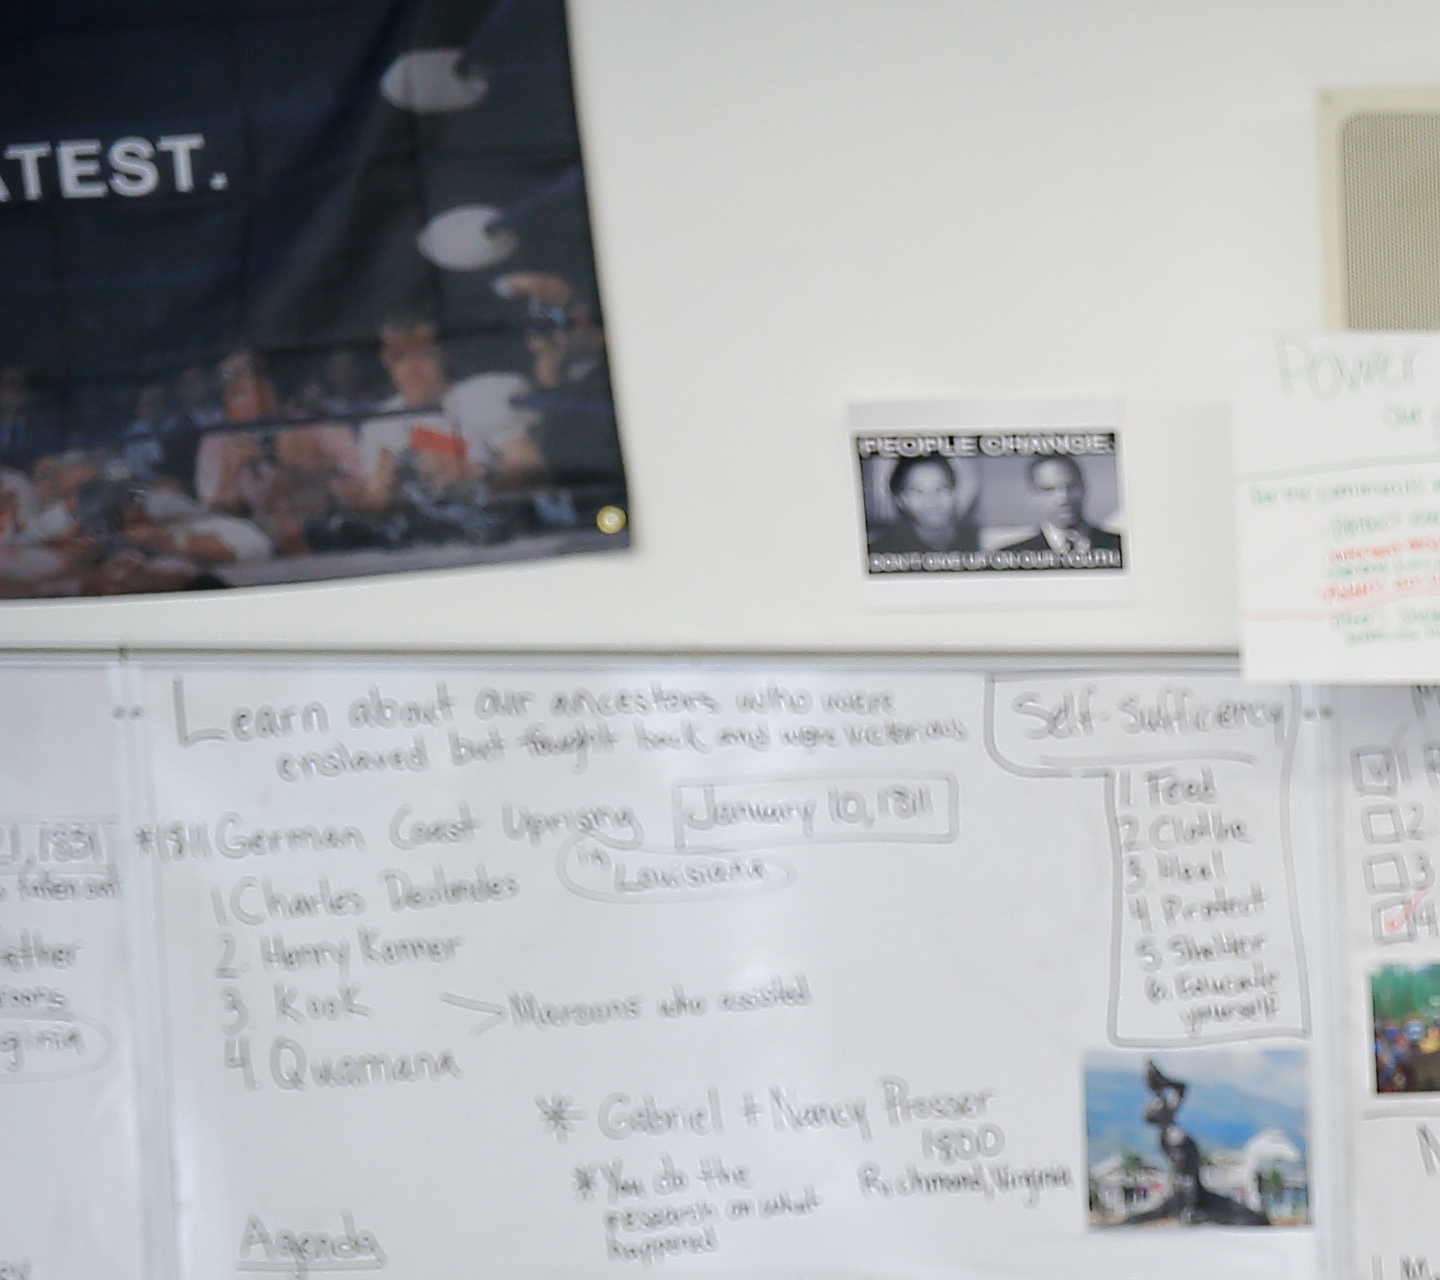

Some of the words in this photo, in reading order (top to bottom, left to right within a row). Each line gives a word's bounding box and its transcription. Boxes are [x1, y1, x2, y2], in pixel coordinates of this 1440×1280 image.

[0, 134, 228, 202] TEST.
[859, 436, 977, 457] PEOPLE
[173, 676, 330, 746] Learn
[349, 682, 457, 730] about
[475, 686, 531, 718] our
[276, 739, 429, 783] enslaved
[215, 814, 366, 862] German
